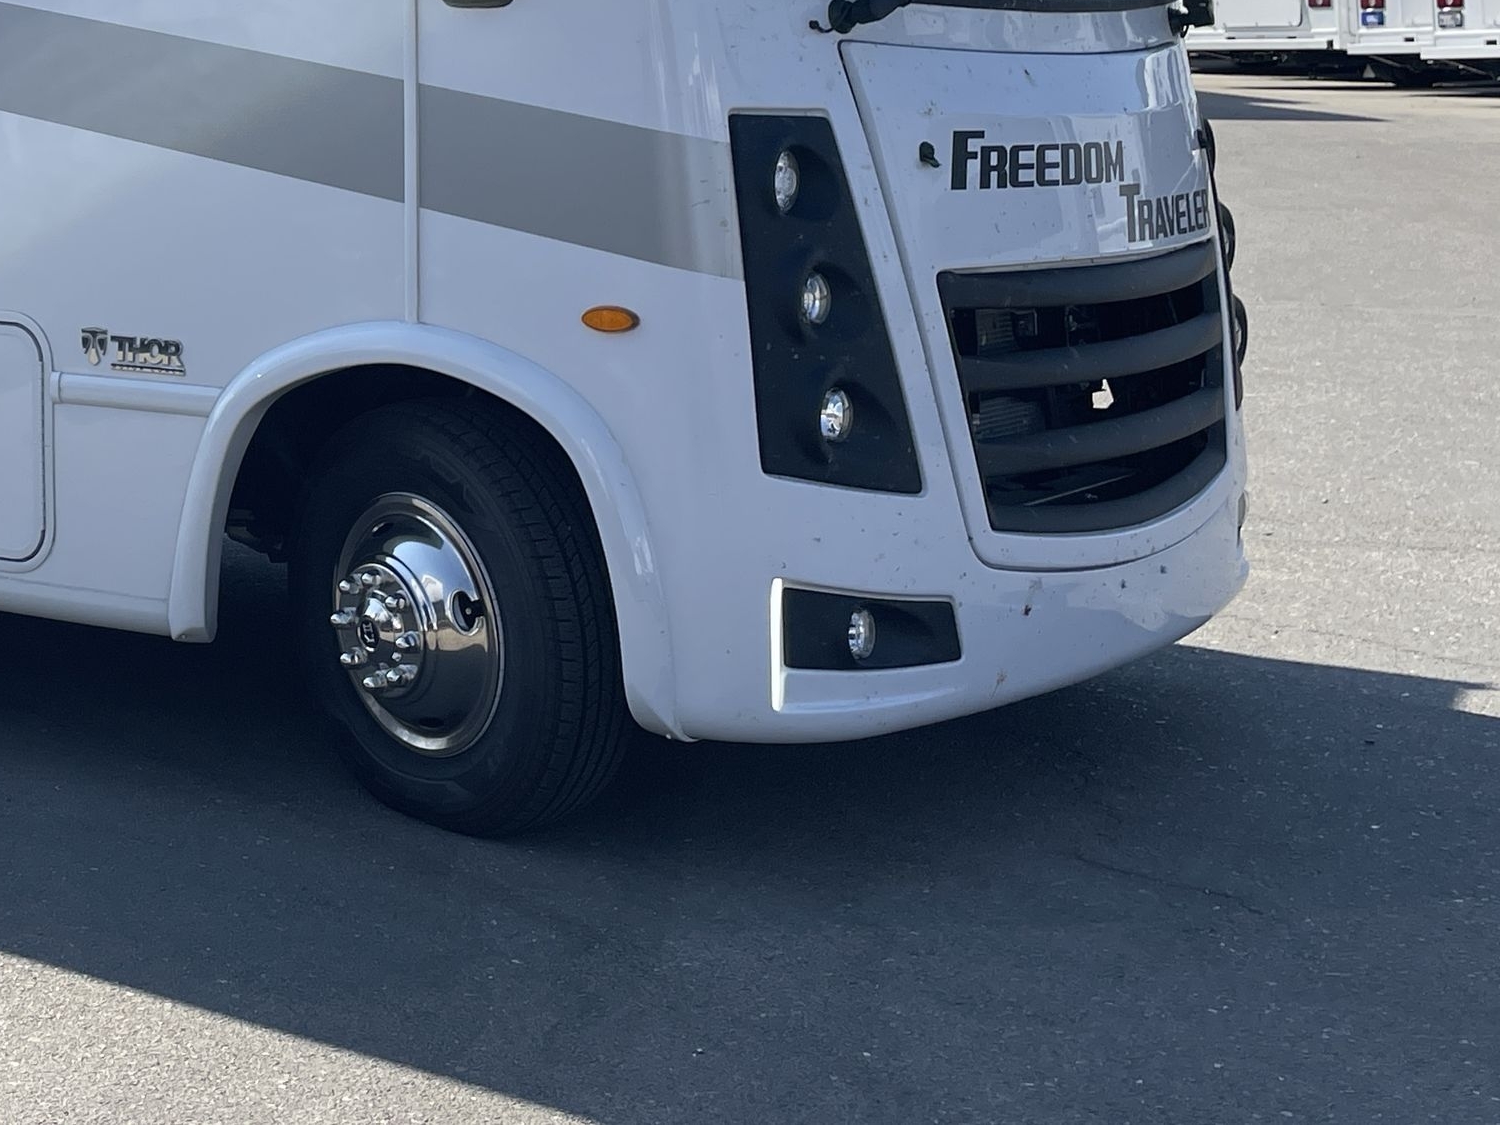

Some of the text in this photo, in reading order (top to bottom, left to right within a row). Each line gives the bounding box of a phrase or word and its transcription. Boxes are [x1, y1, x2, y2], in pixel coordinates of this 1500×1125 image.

[950, 130, 1125, 190] FREEDOM
[1119, 183, 1211, 243] TRAVELER
[110, 335, 183, 368] THOR
